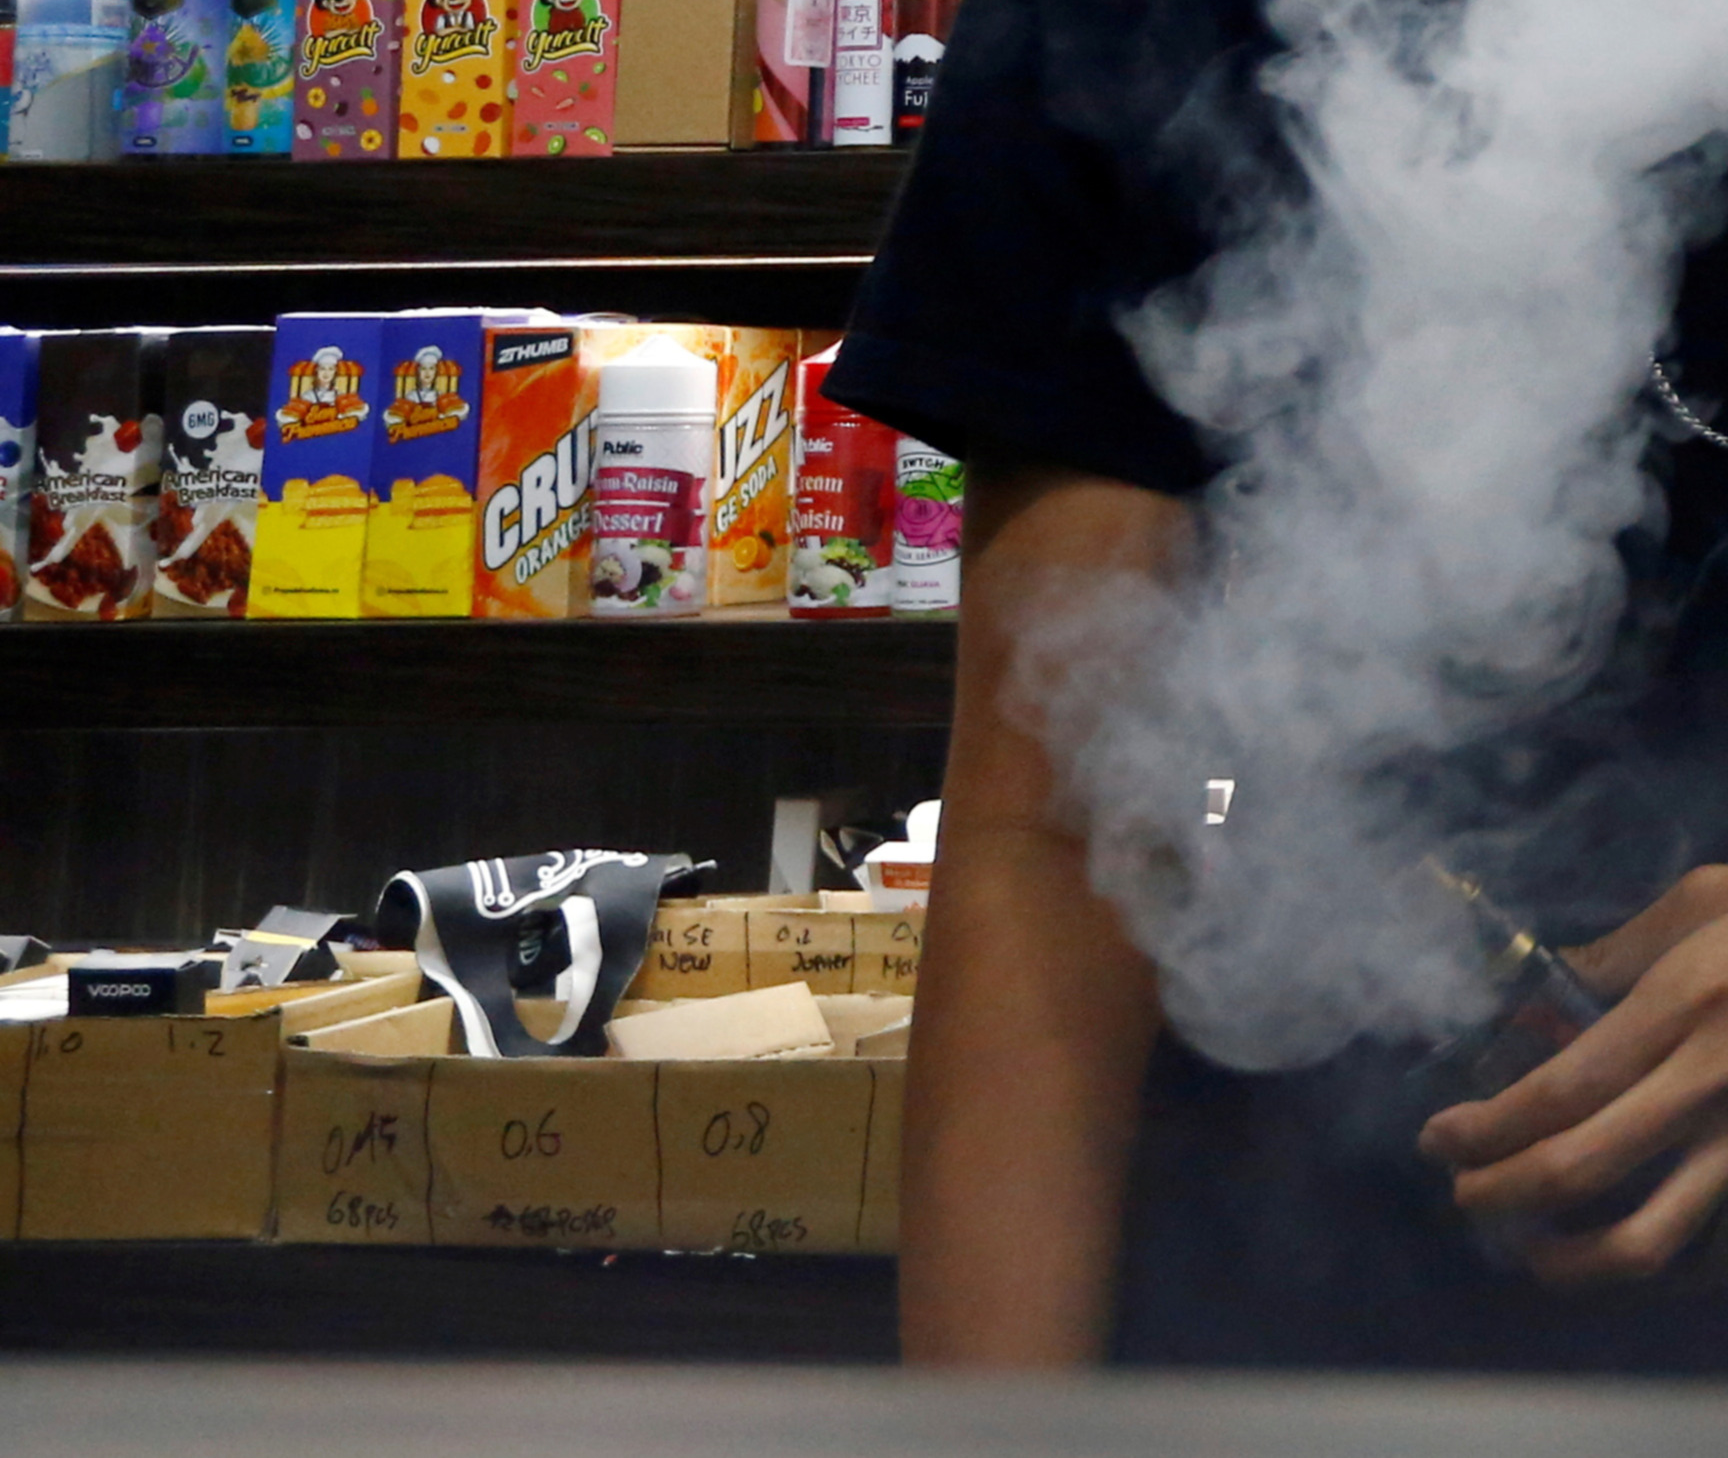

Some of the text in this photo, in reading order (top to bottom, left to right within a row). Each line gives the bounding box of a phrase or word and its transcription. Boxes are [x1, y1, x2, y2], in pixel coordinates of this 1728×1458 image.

[603, 440, 643, 456] Public
[36, 471, 126, 495] American
[164, 468, 259, 492] American
[740, 457, 777, 508] SODA
[49, 487, 126, 508] Breakfast
[178, 484, 258, 507] Breakfast
[514, 496, 590, 584] ORANGE
